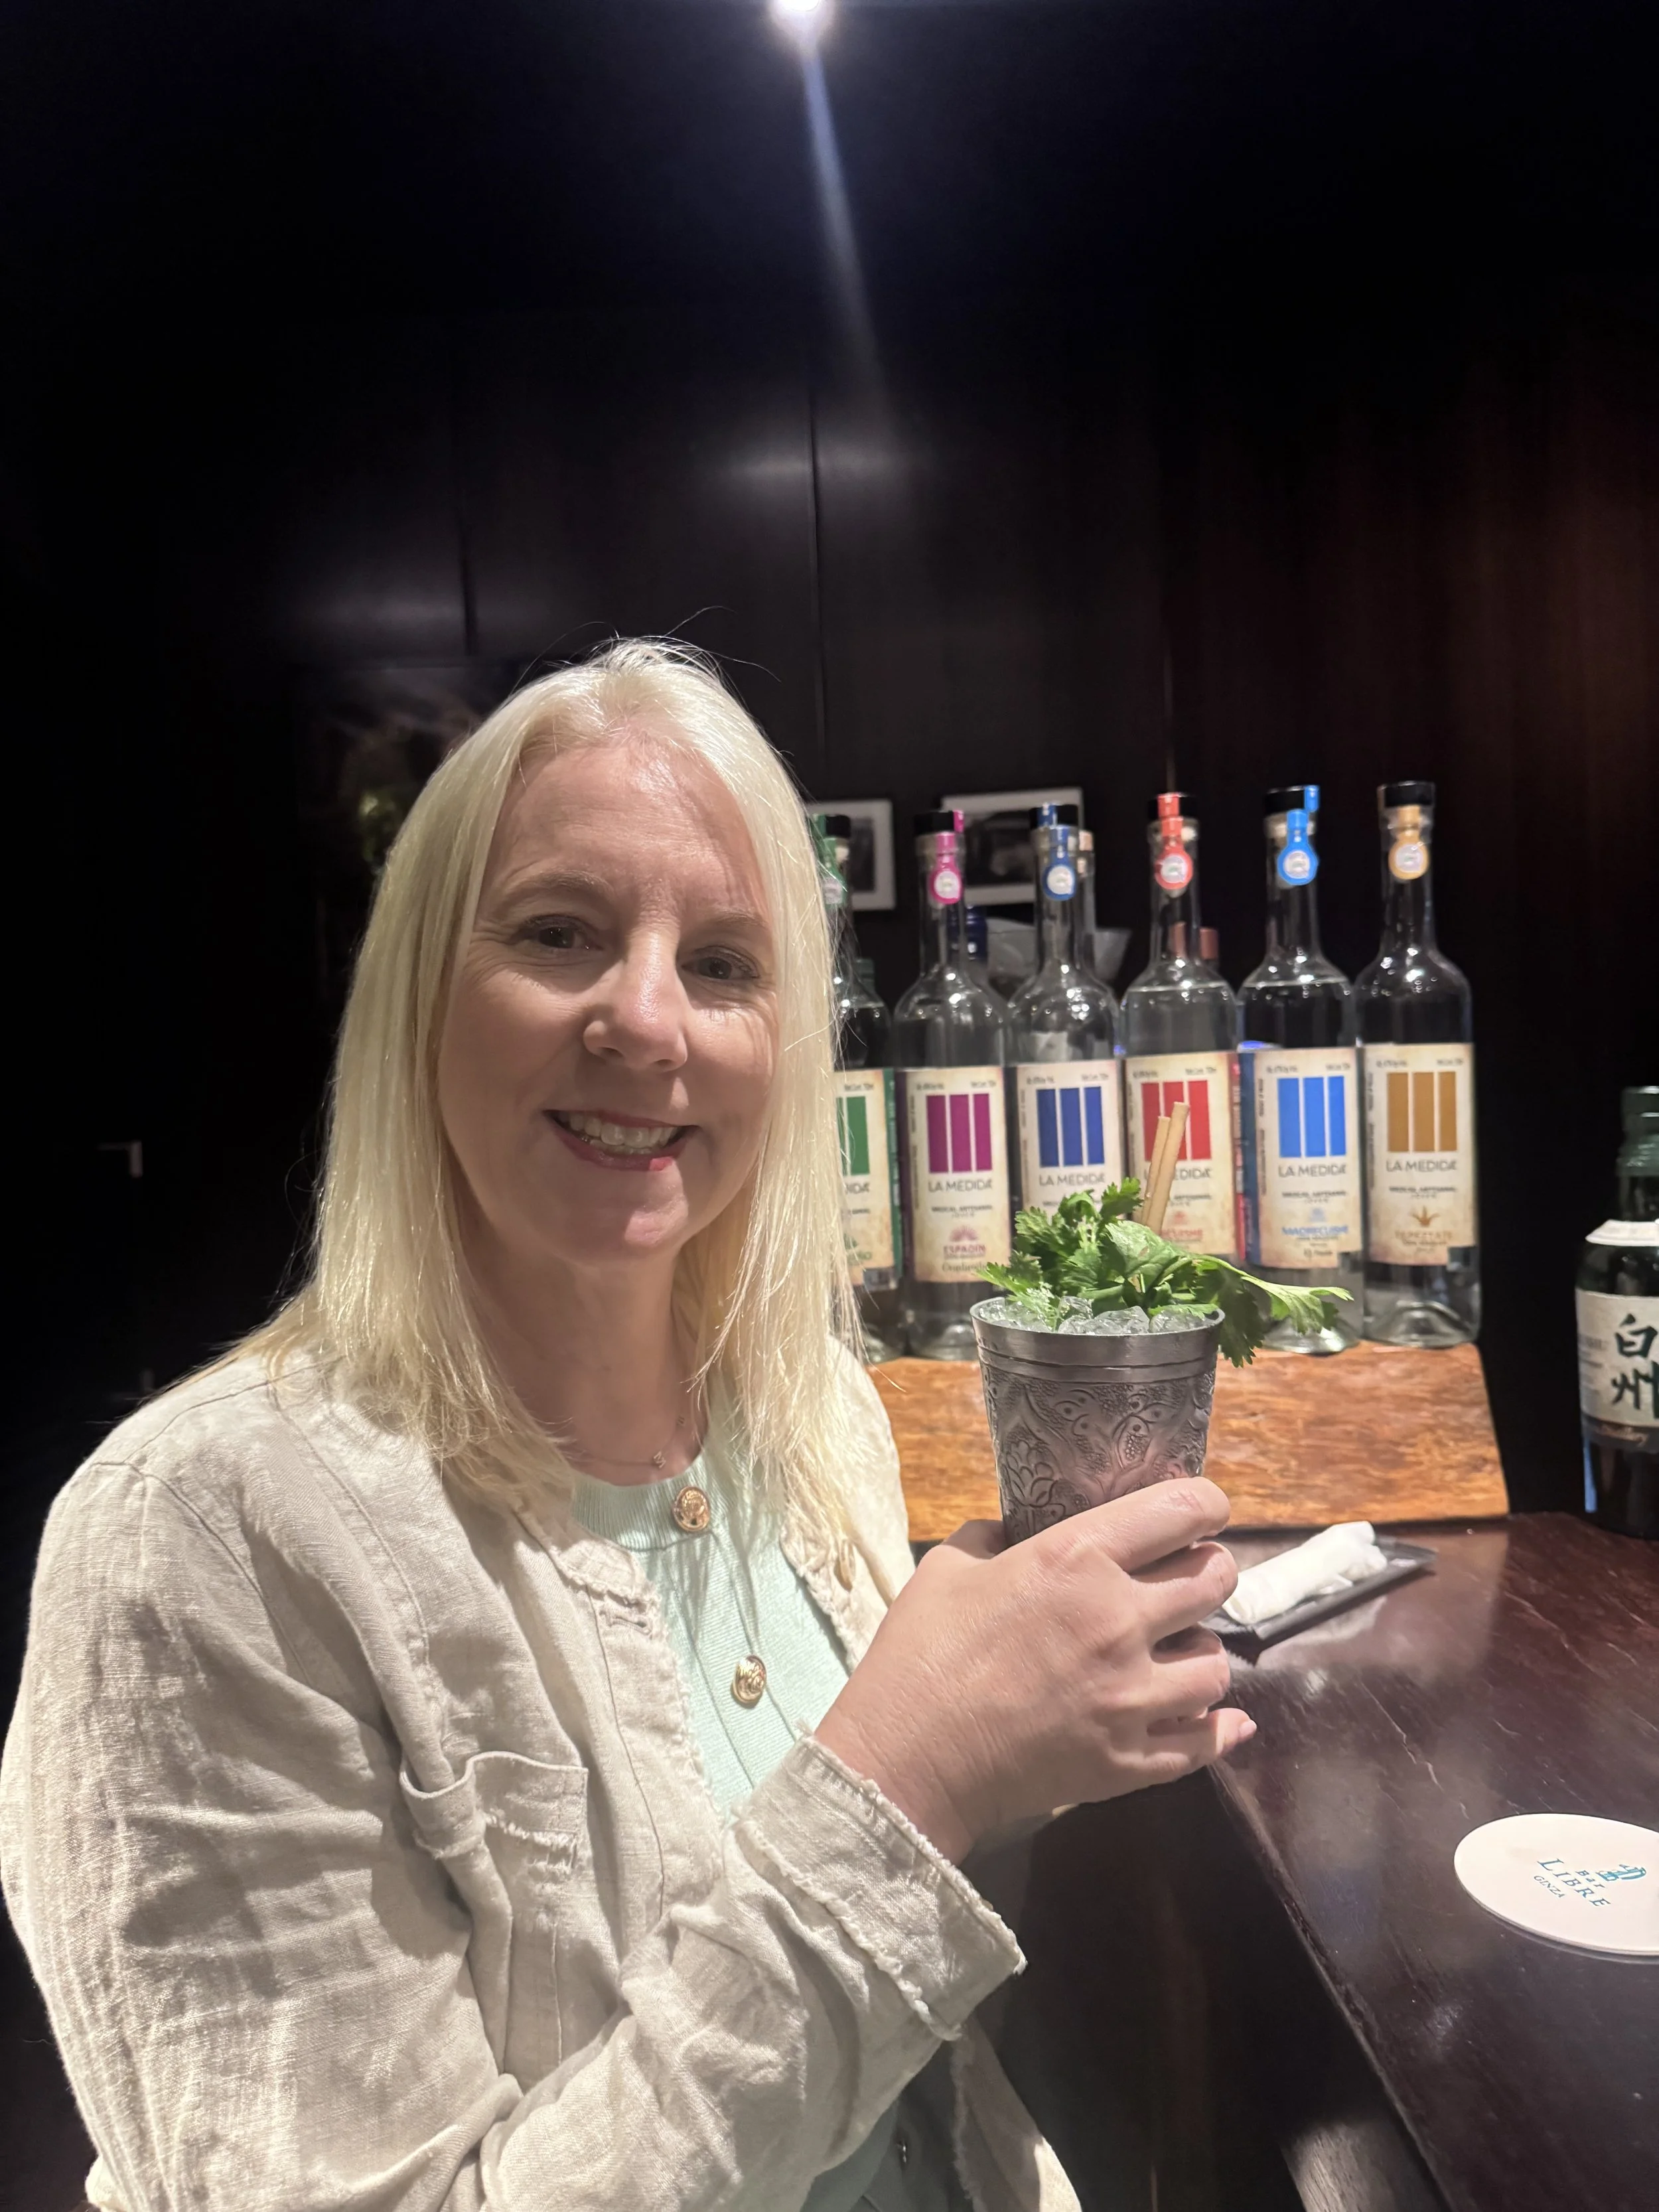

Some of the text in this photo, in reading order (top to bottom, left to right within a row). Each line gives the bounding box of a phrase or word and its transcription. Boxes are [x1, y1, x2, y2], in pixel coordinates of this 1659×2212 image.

[1277, 1163, 1346, 1178] LA MEDIDA
[1386, 1159, 1457, 1173] LA MEDIDA
[928, 1179, 993, 1193] LA MEDIDA
[1039, 1172, 1106, 1187] LA MEDIDA
[1611, 1313, 1659, 1420] 白州
[1534, 1875, 1565, 1898] GINZA
[1537, 1858, 1611, 1907] LIBRE
[1575, 1870, 1606, 1888] Bar
